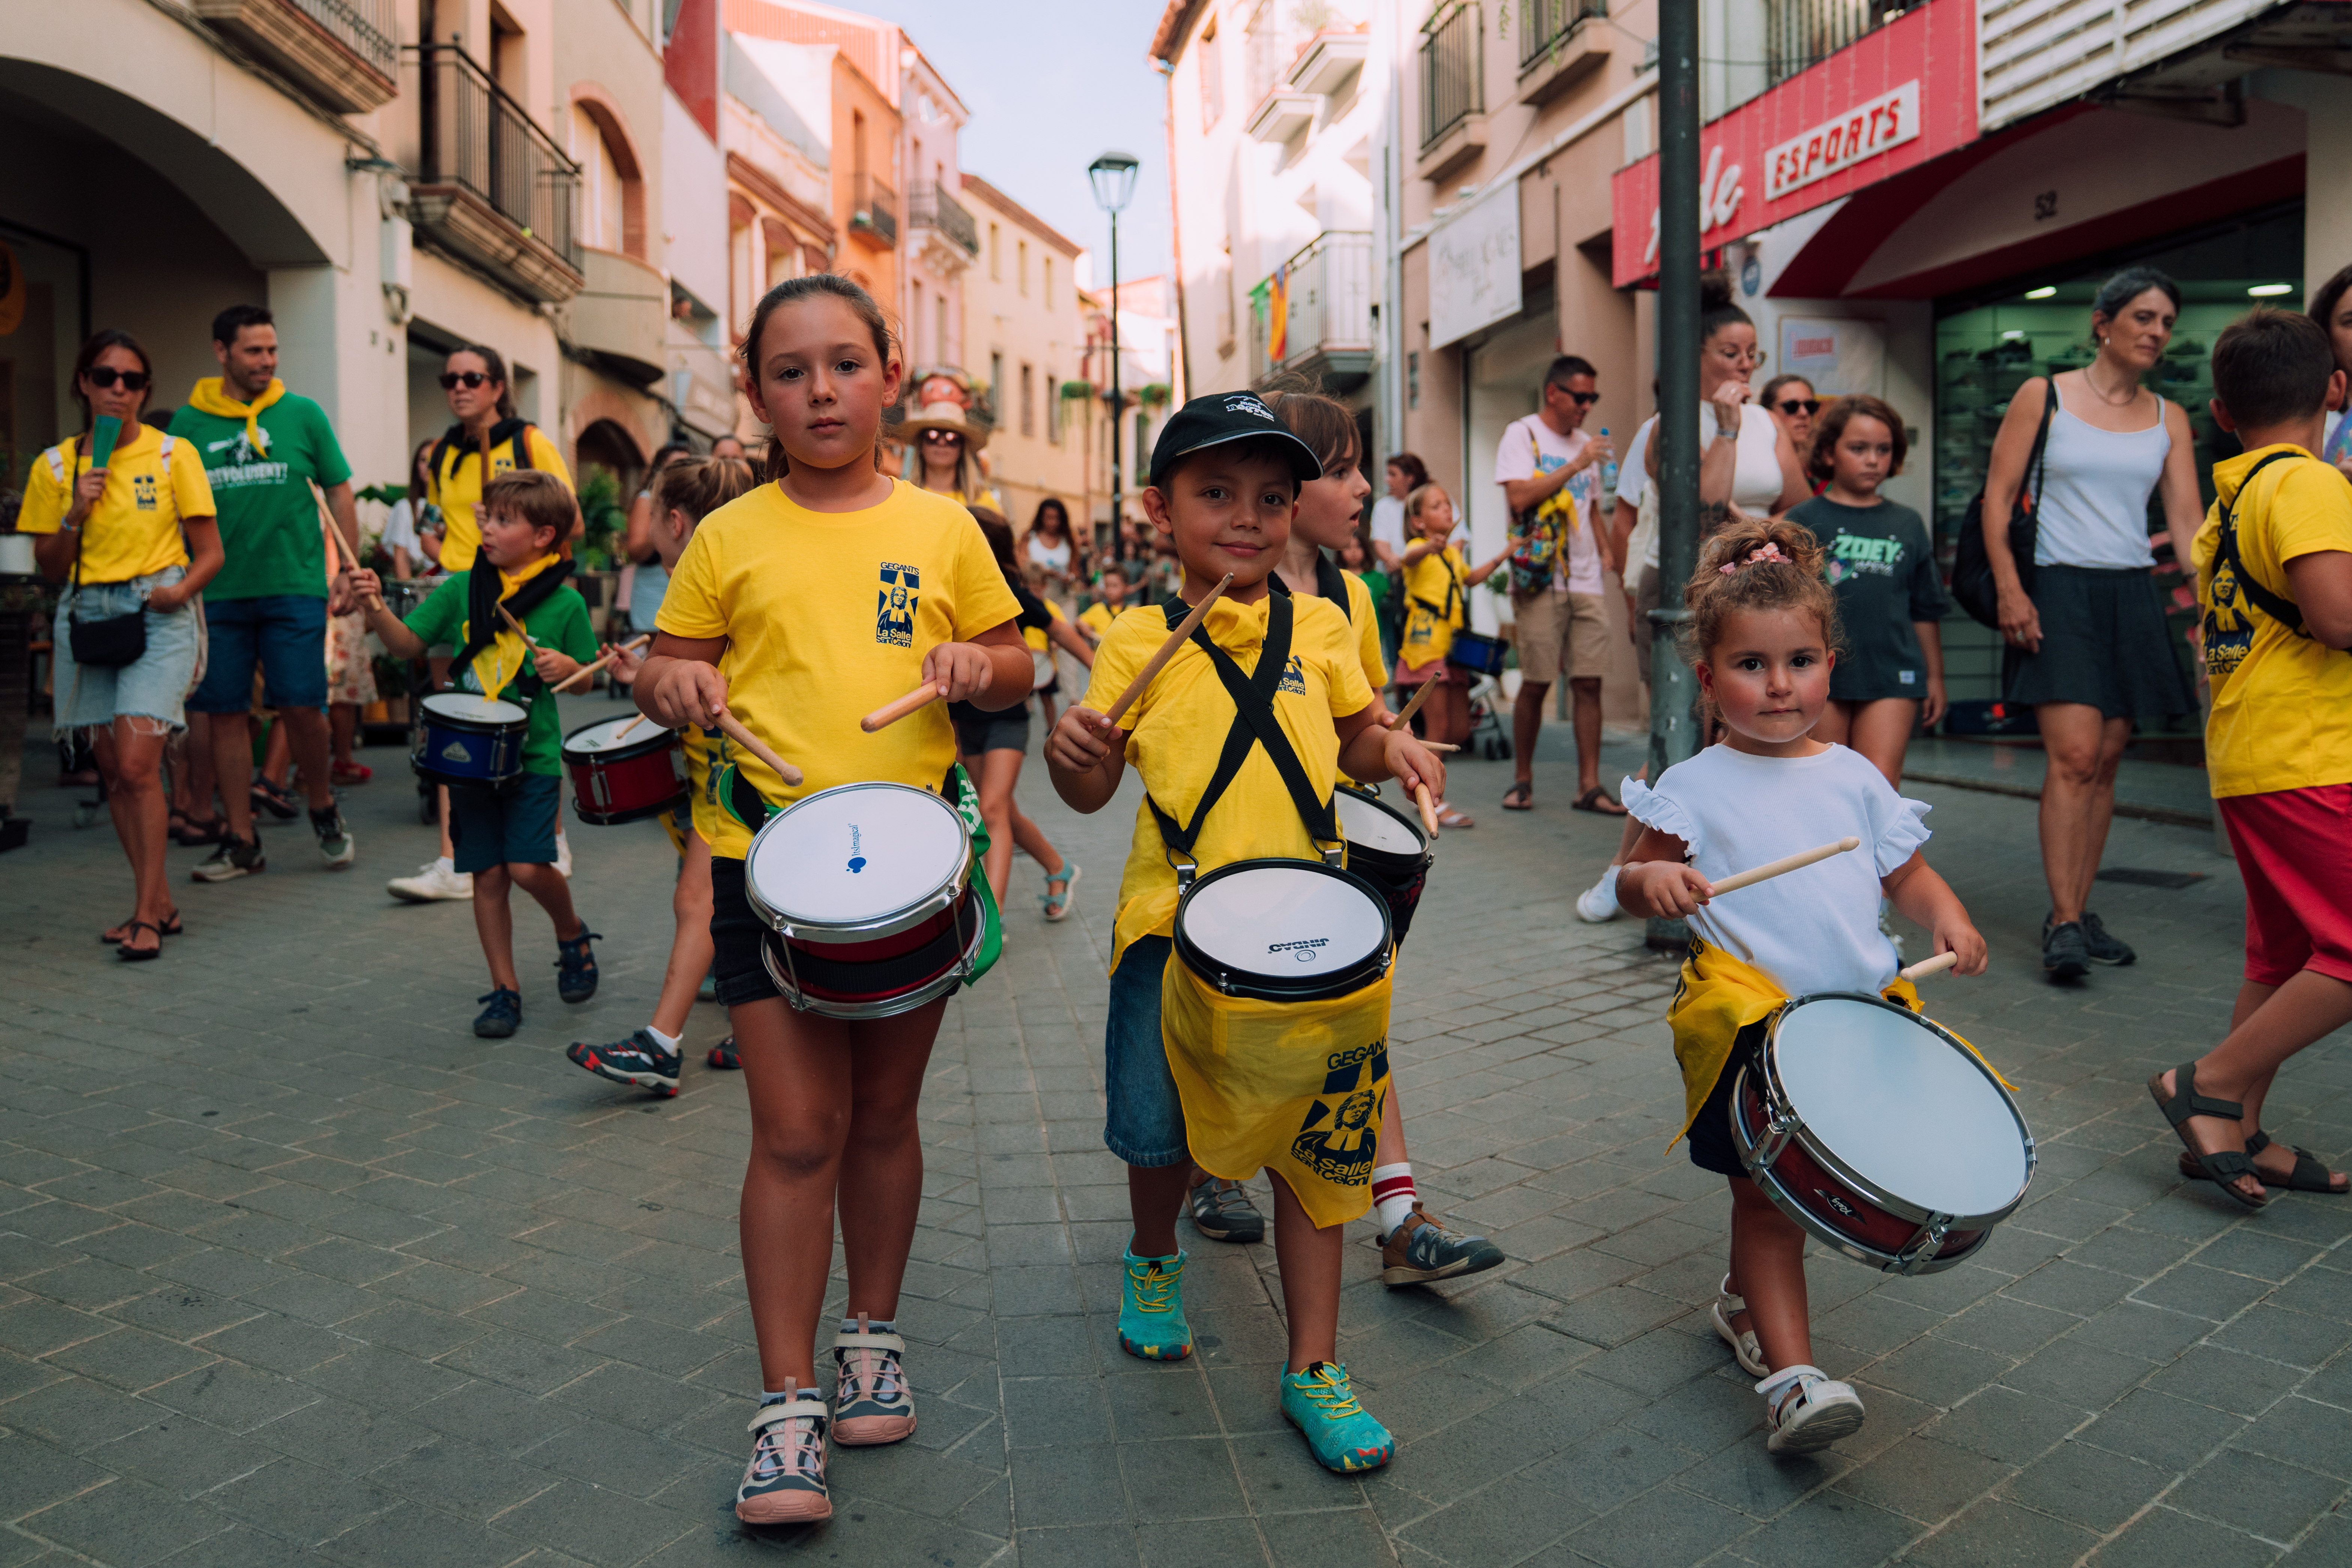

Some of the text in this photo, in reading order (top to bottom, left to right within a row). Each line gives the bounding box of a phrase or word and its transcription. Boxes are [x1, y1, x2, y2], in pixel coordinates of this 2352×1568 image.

[1775, 98, 1901, 189] ESPORTS
[1240, 401, 1261, 409] mont
[1834, 535, 1903, 562] ZOEY
[880, 562, 919, 575] GEGANTS
[877, 627, 911, 641] La Salle
[2216, 644, 2248, 661] Salle
[1283, 677, 1305, 689] Salle
[849, 824, 861, 856] ItsImagical
[1269, 938, 1330, 952] JINBAO
[1327, 1035, 1386, 1070] GEGAN
[1295, 1140, 1371, 1176] La Salle
[1321, 1171, 1369, 1186] Celoni
[1764, 1371, 1791, 1387] biomecanics
